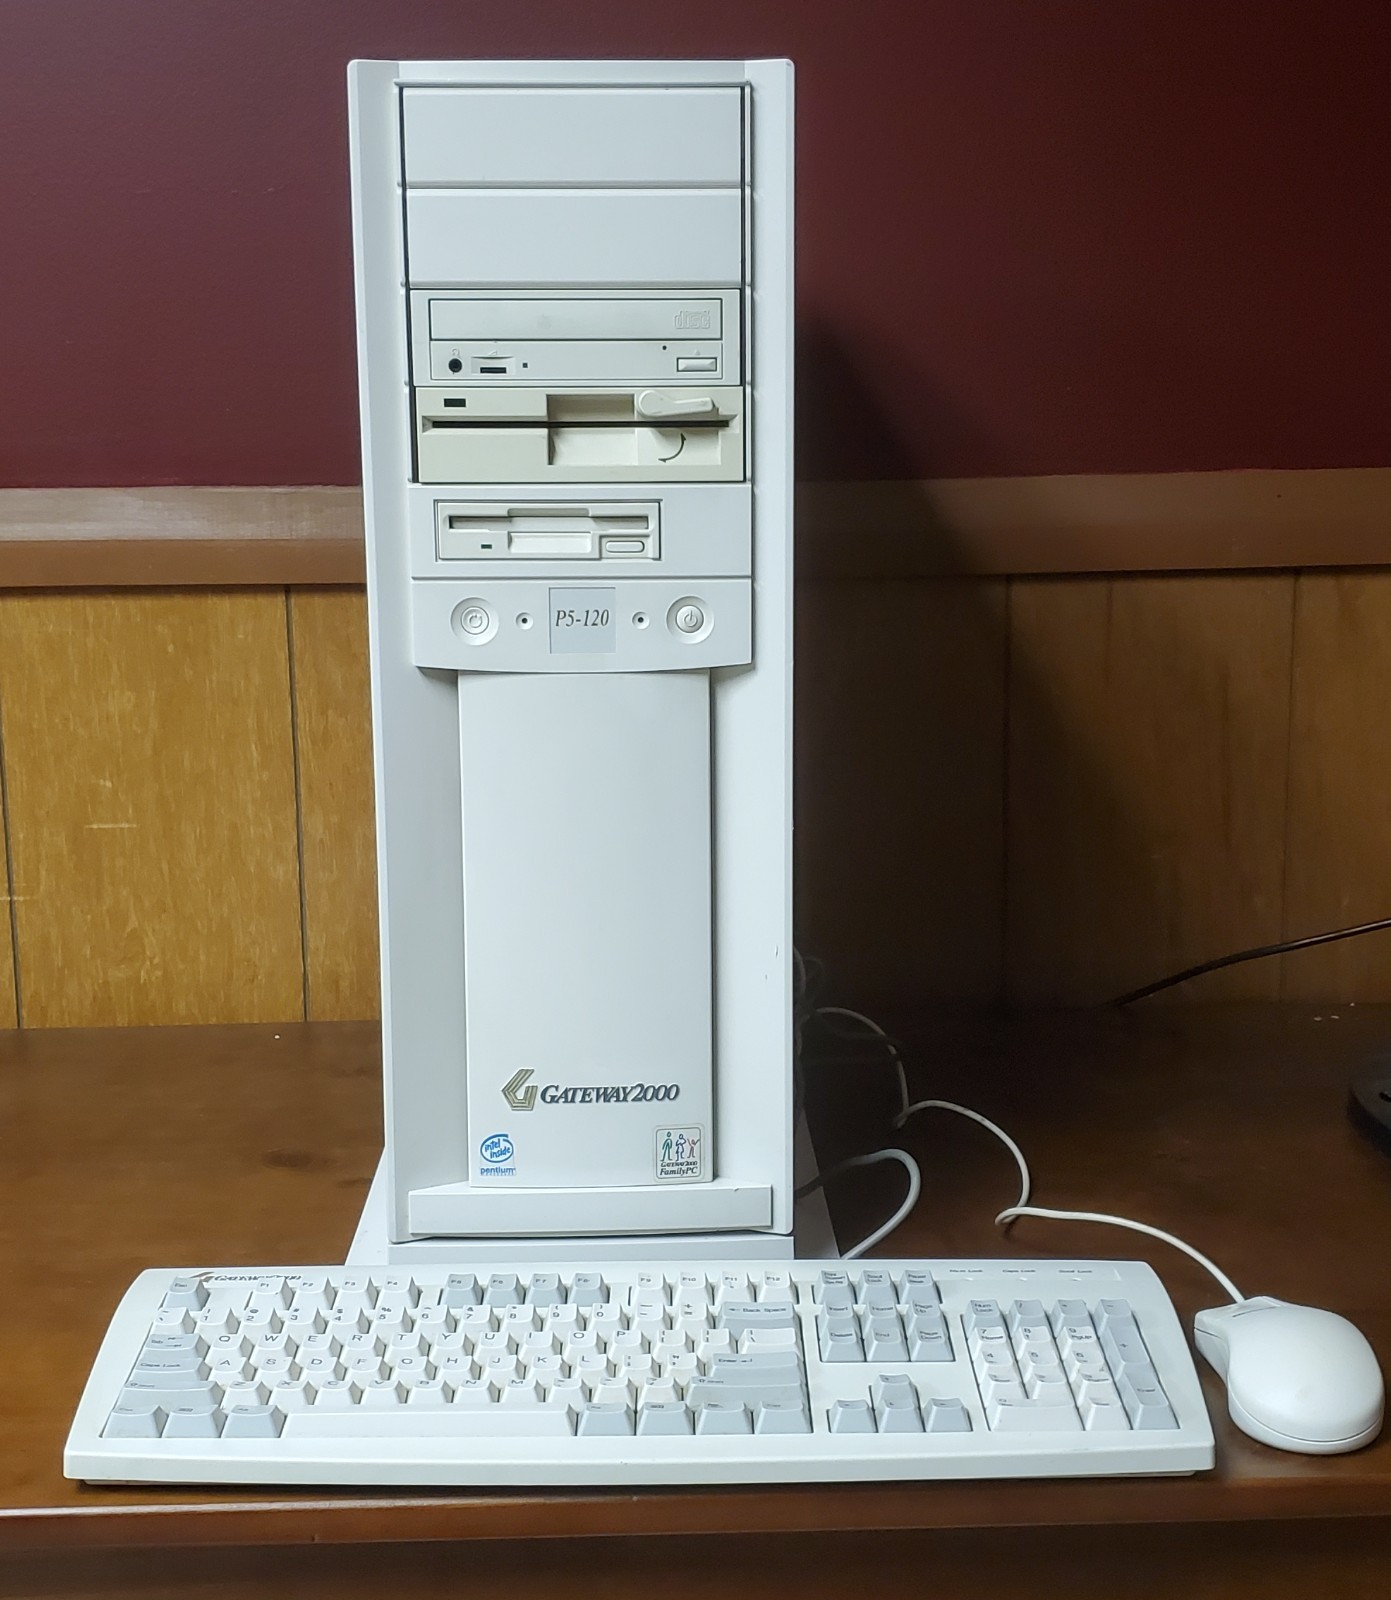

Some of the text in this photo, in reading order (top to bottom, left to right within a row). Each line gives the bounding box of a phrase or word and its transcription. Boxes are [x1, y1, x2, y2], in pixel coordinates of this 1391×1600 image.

[555, 609, 610, 628] P5-120
[540, 1083, 680, 1105] GATEWAY2000
[484, 1138, 501, 1152] intel
[490, 1145, 511, 1159] inside
[616, 1330, 626, 1338] P
